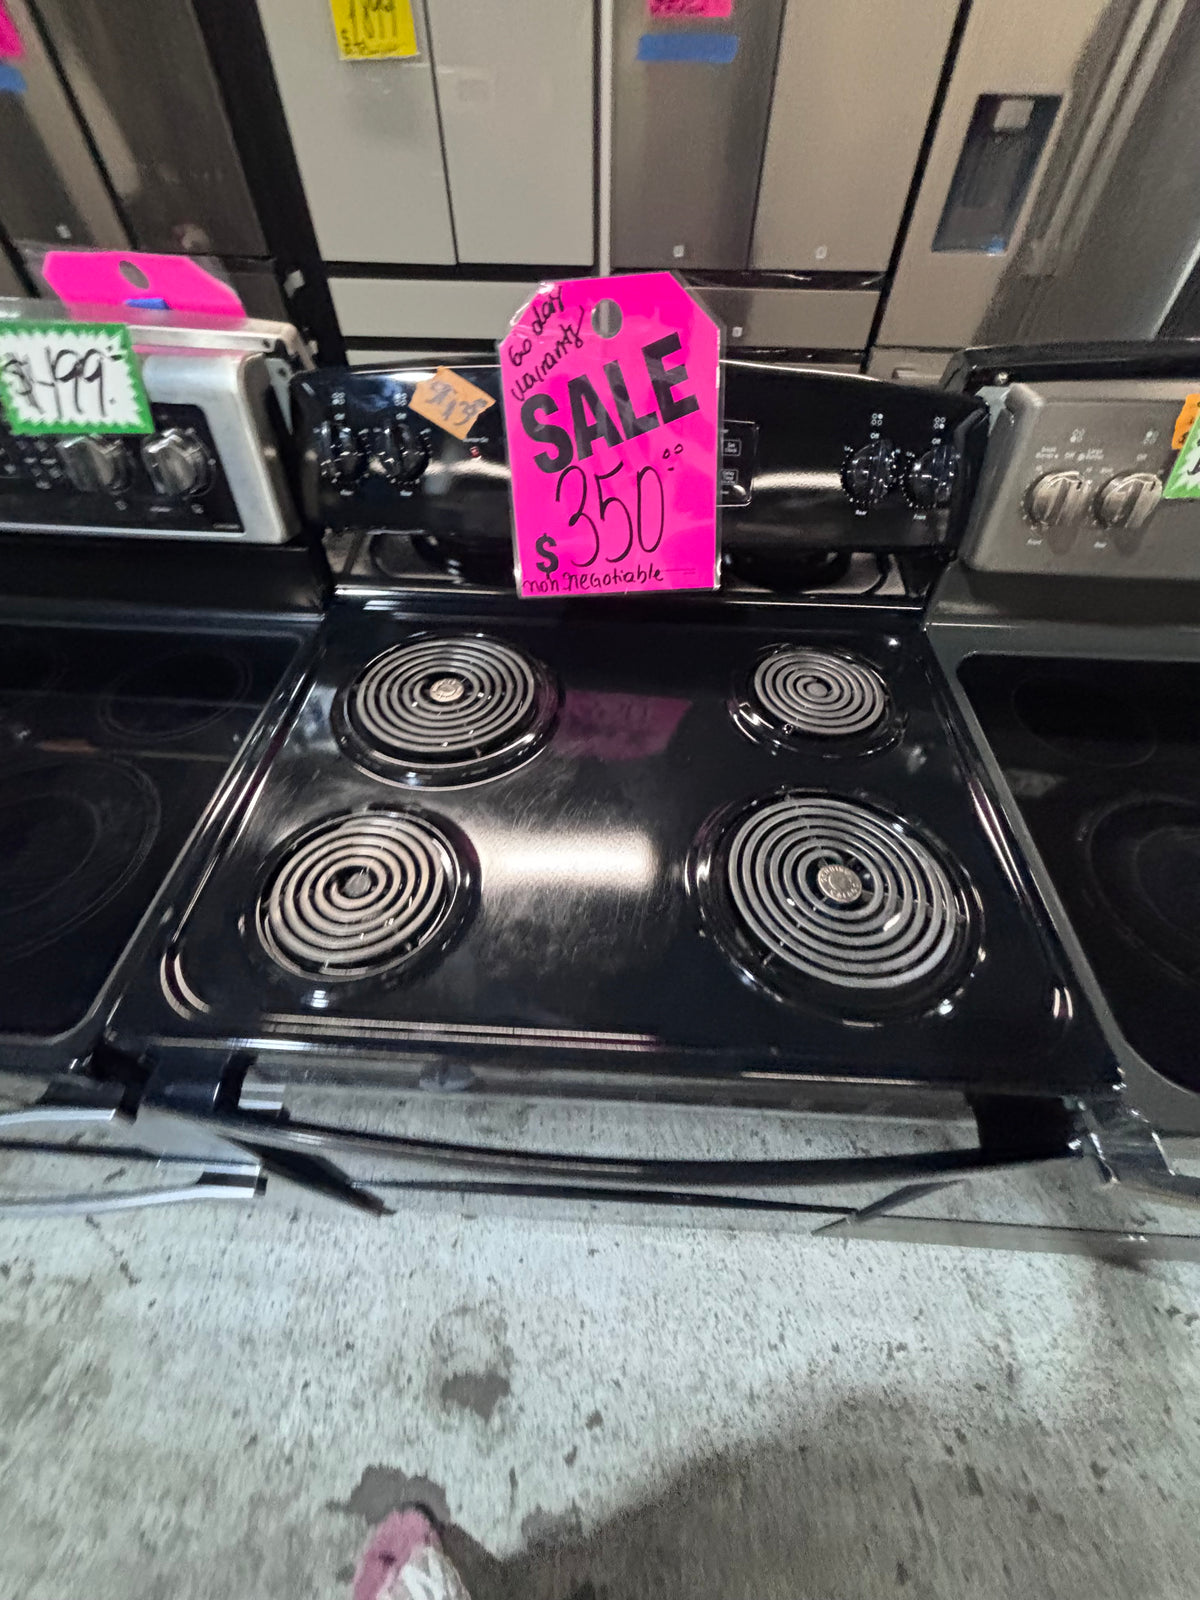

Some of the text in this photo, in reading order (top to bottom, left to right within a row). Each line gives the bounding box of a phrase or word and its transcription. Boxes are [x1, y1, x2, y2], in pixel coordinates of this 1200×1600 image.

[508, 286, 564, 367] 60 day
[520, 331, 700, 474] SALE
[555, 461, 664, 567] 350
